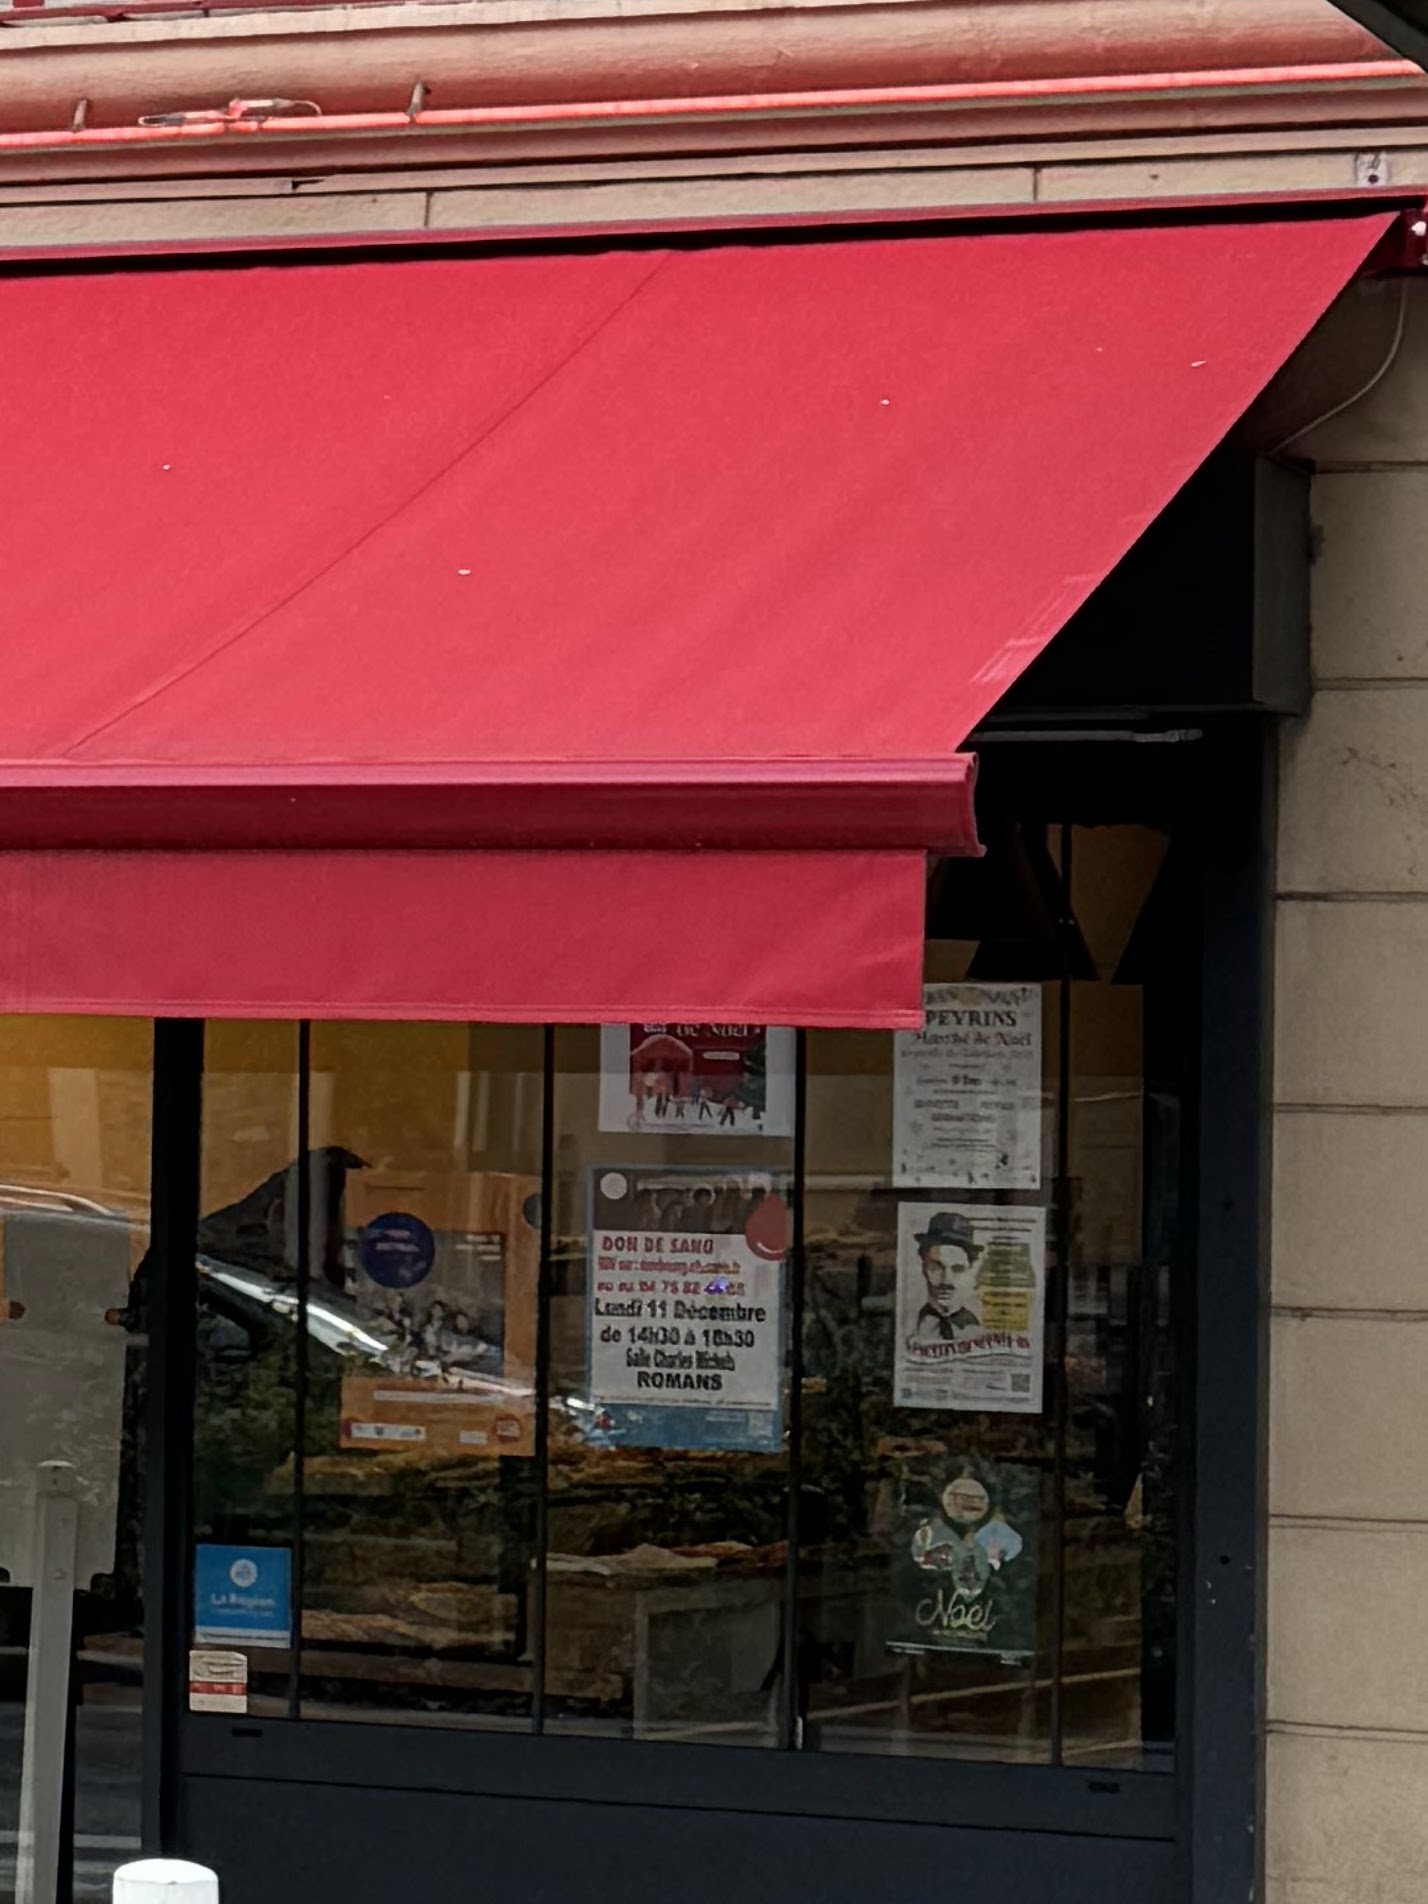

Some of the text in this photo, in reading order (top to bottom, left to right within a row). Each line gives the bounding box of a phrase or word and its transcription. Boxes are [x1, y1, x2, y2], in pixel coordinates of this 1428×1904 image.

[925, 1009, 1017, 1027] PEYRINS
[602, 1236, 638, 1252] DON
[644, 1237, 665, 1253] DE
[595, 1298, 767, 1322] Lundi 11 Décembre
[600, 1326, 622, 1343] de
[636, 1371, 723, 1391] ROMANS
